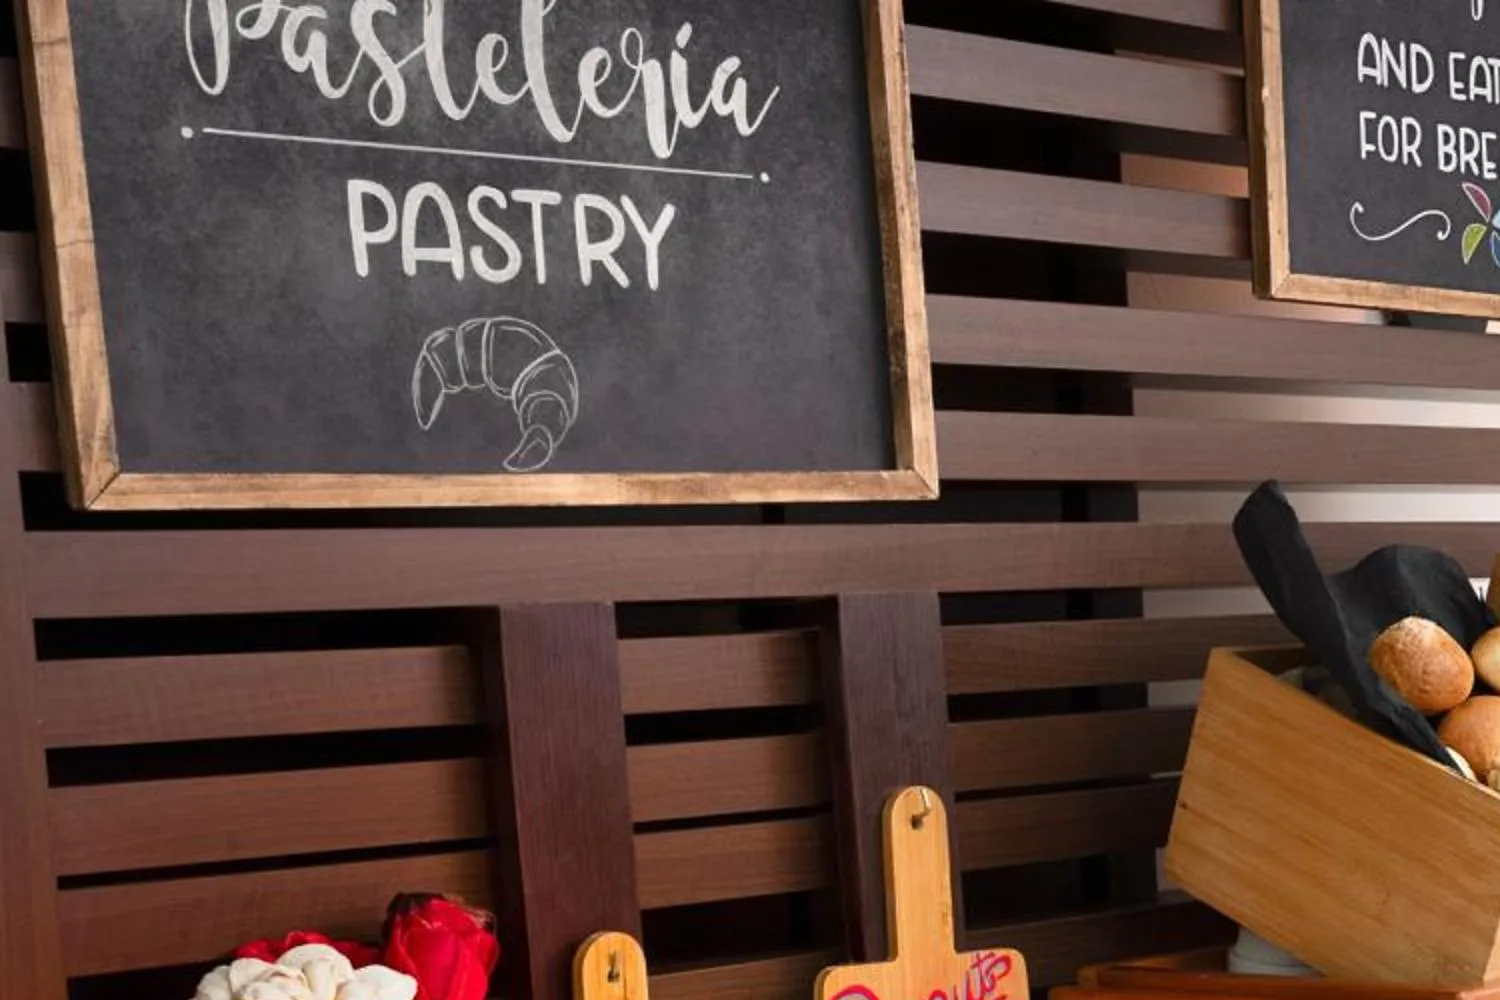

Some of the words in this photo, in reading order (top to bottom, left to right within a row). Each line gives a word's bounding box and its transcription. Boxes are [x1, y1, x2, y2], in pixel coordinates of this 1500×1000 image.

[1357, 32, 1435, 95] AND
[1359, 111, 1423, 168] FOR
[346, 178, 677, 291] PASTRY
